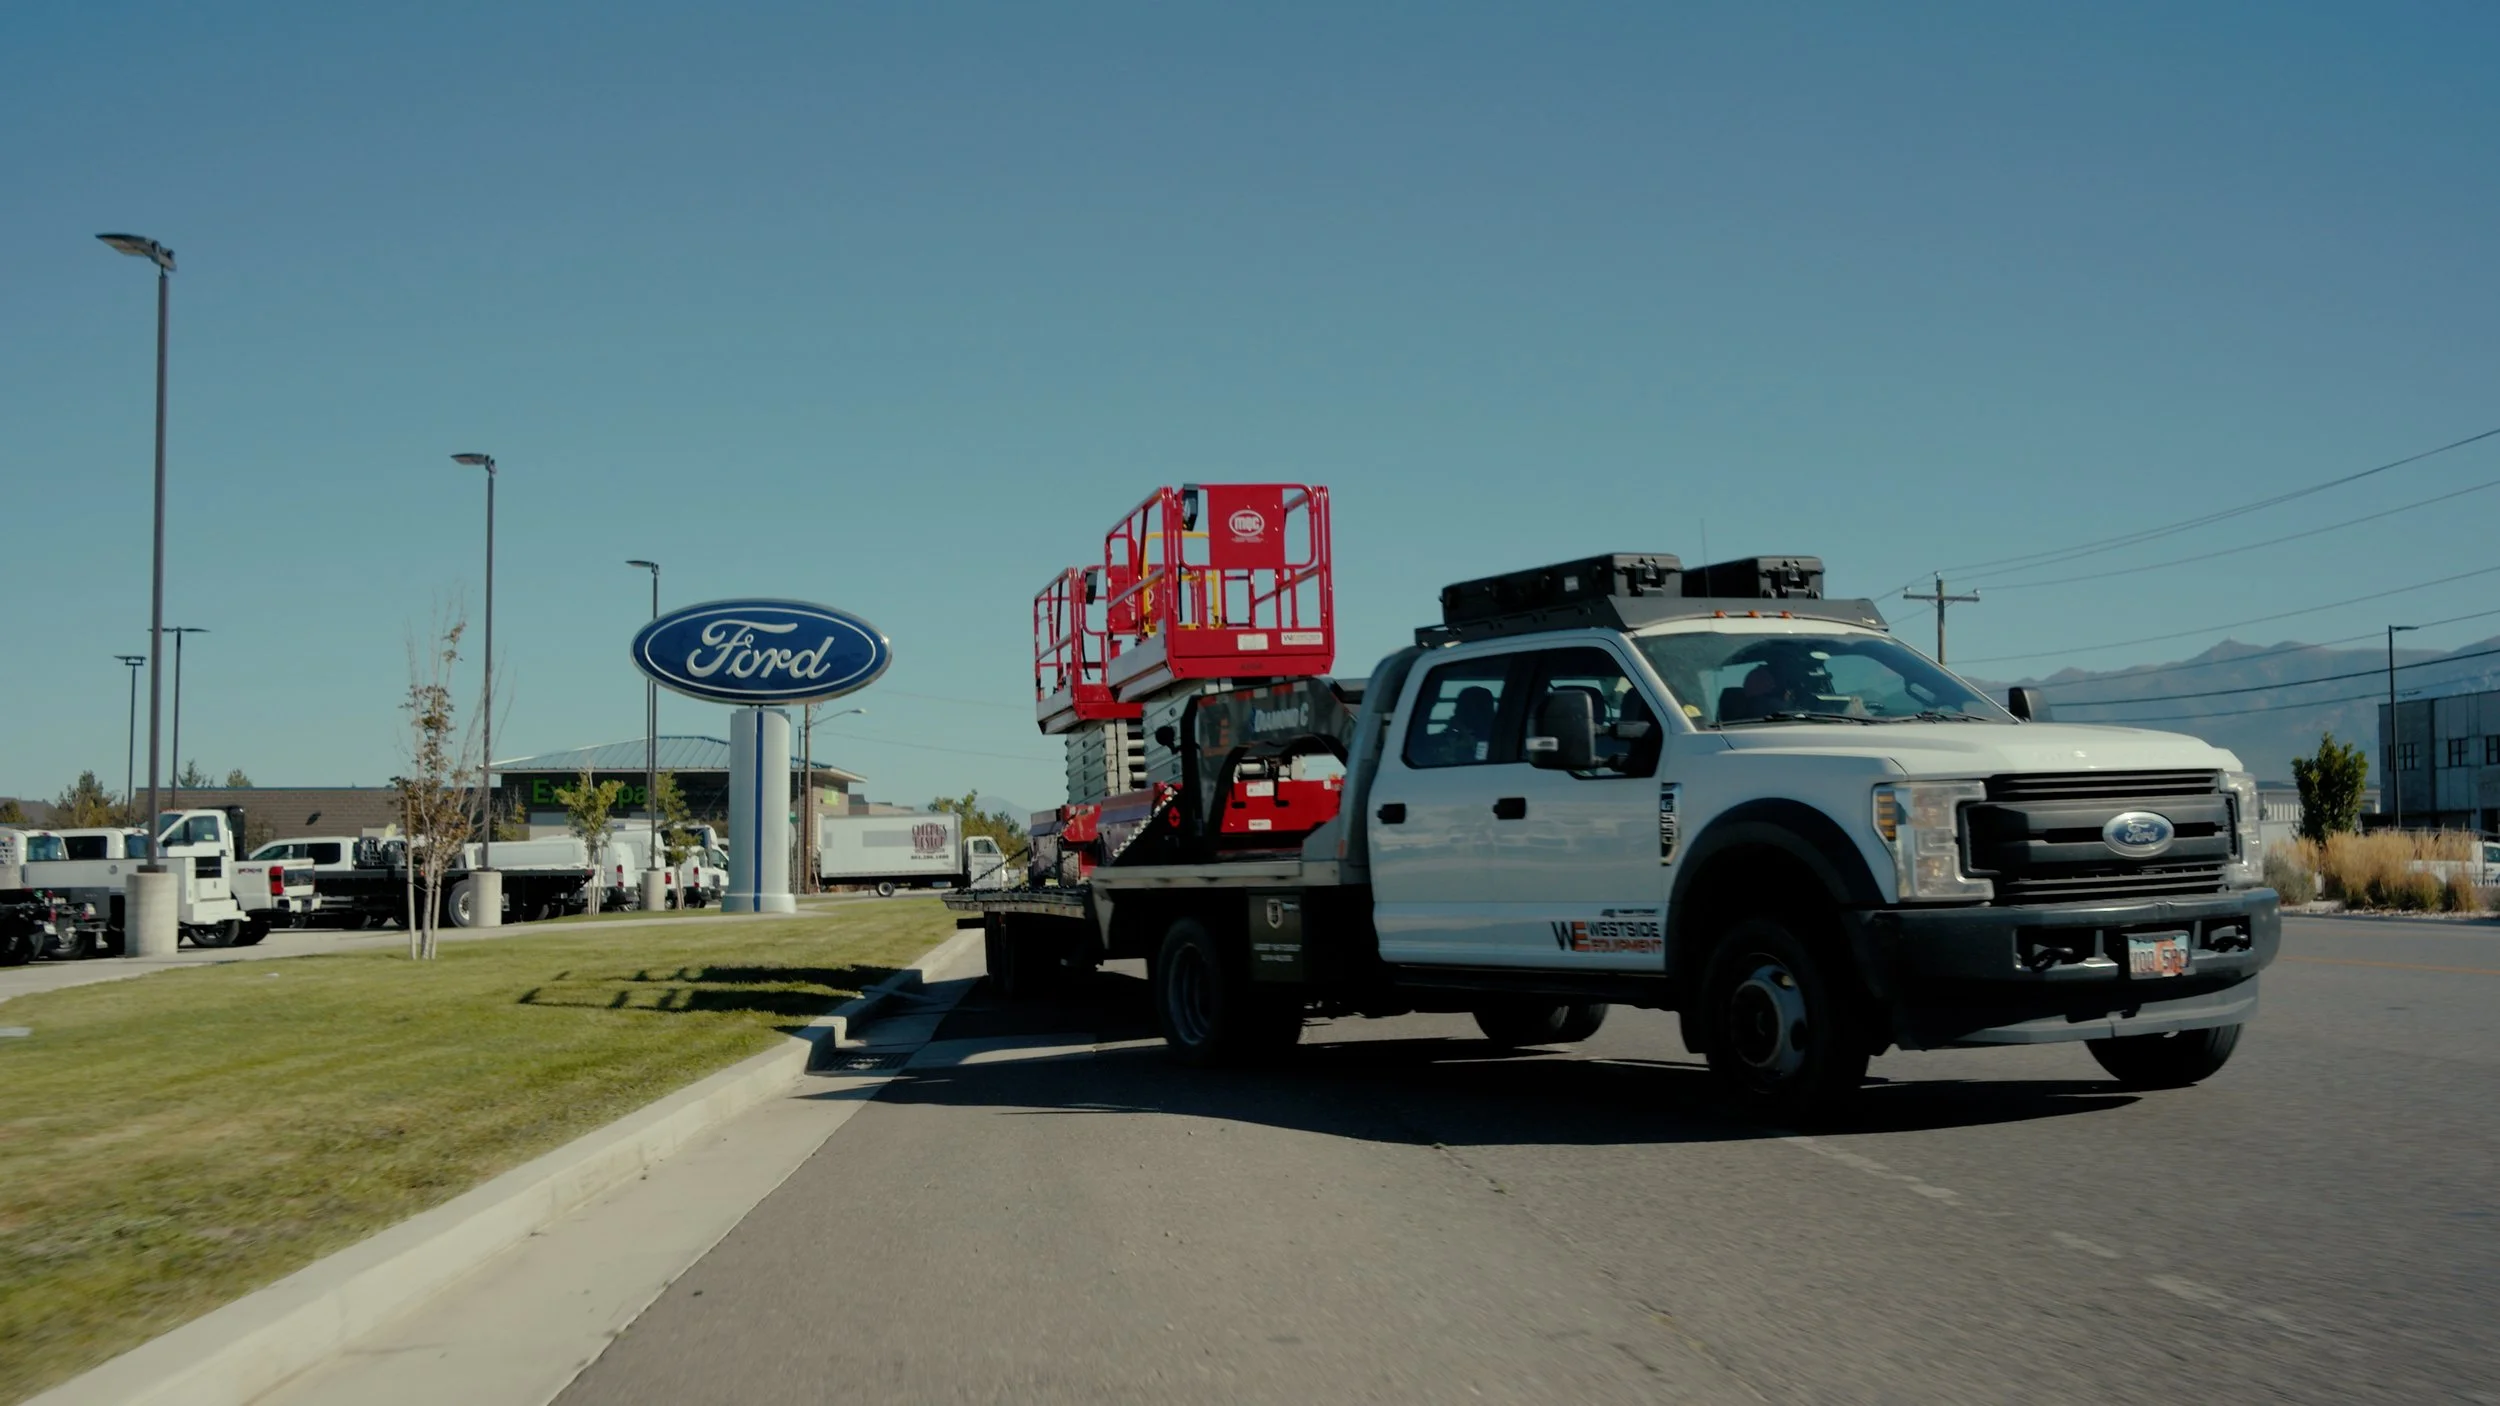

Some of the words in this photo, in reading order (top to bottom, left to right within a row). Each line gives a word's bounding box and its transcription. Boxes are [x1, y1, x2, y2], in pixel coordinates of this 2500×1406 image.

[686, 619, 835, 679] Ford
[2124, 823, 2158, 843] Ford
[1587, 921, 1660, 937] WESTSIDE
